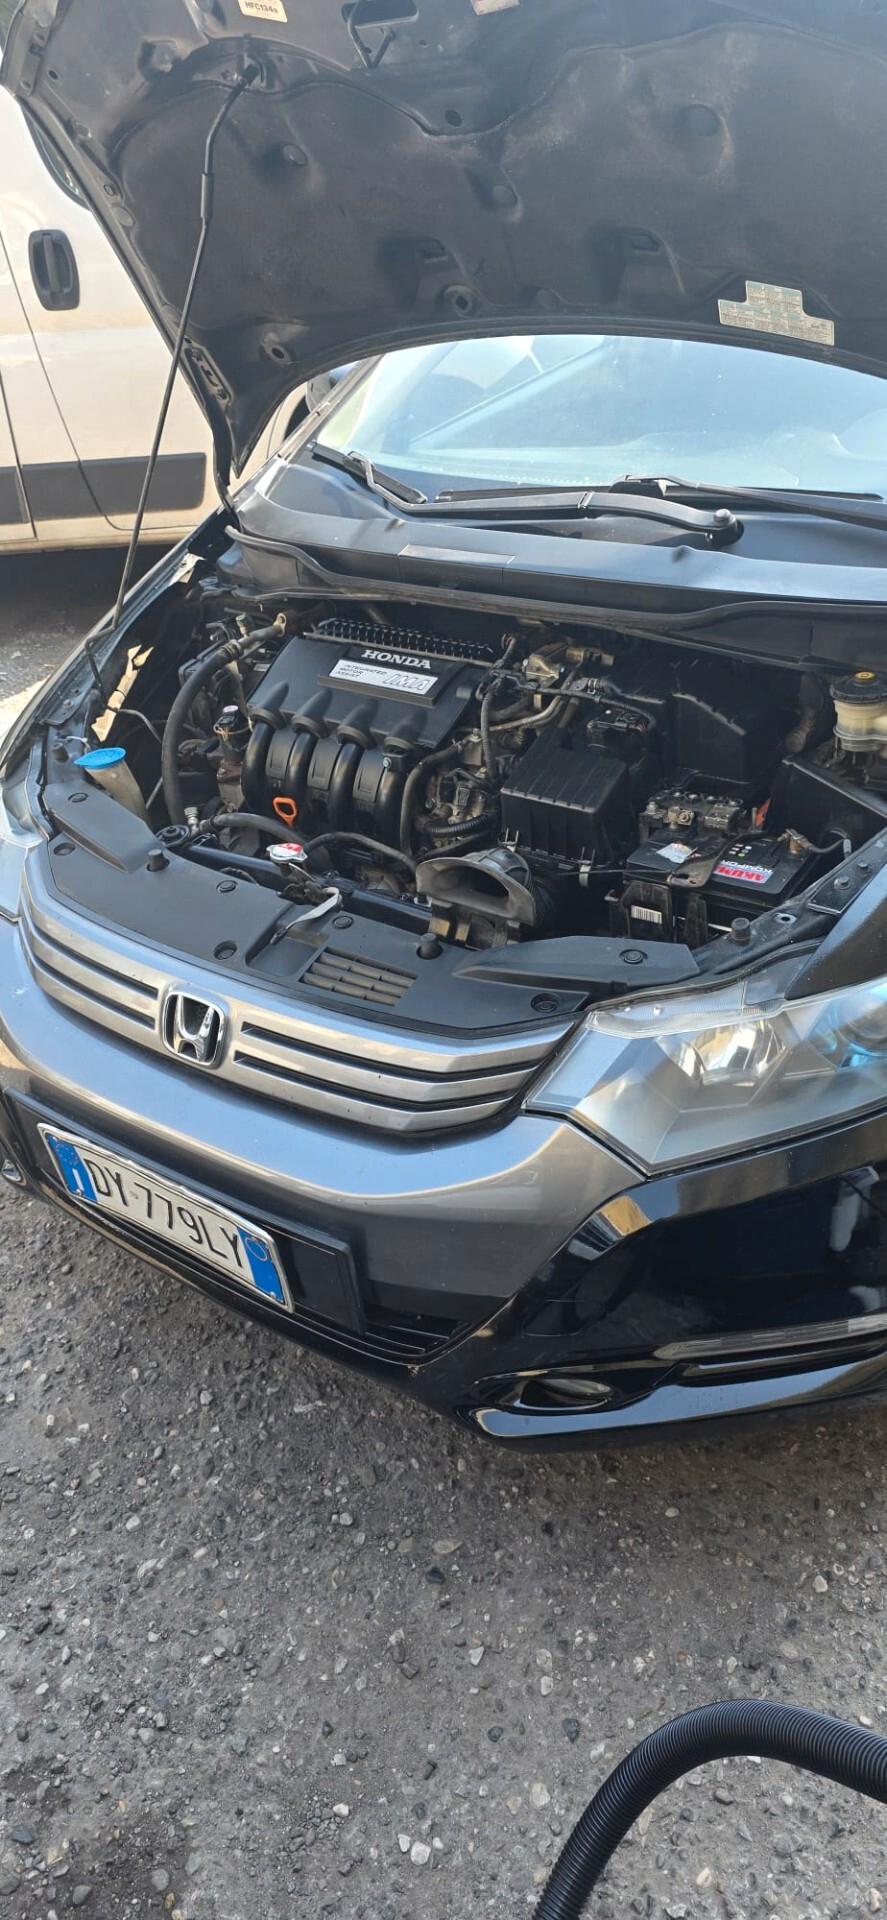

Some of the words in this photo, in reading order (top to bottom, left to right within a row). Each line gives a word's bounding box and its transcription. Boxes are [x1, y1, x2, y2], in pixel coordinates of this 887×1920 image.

[361, 649, 431, 668] HONDA
[717, 866, 764, 881] AKUM
[720, 859, 773, 872] KOMFOR
[134, 1181, 243, 1268] 779LY
